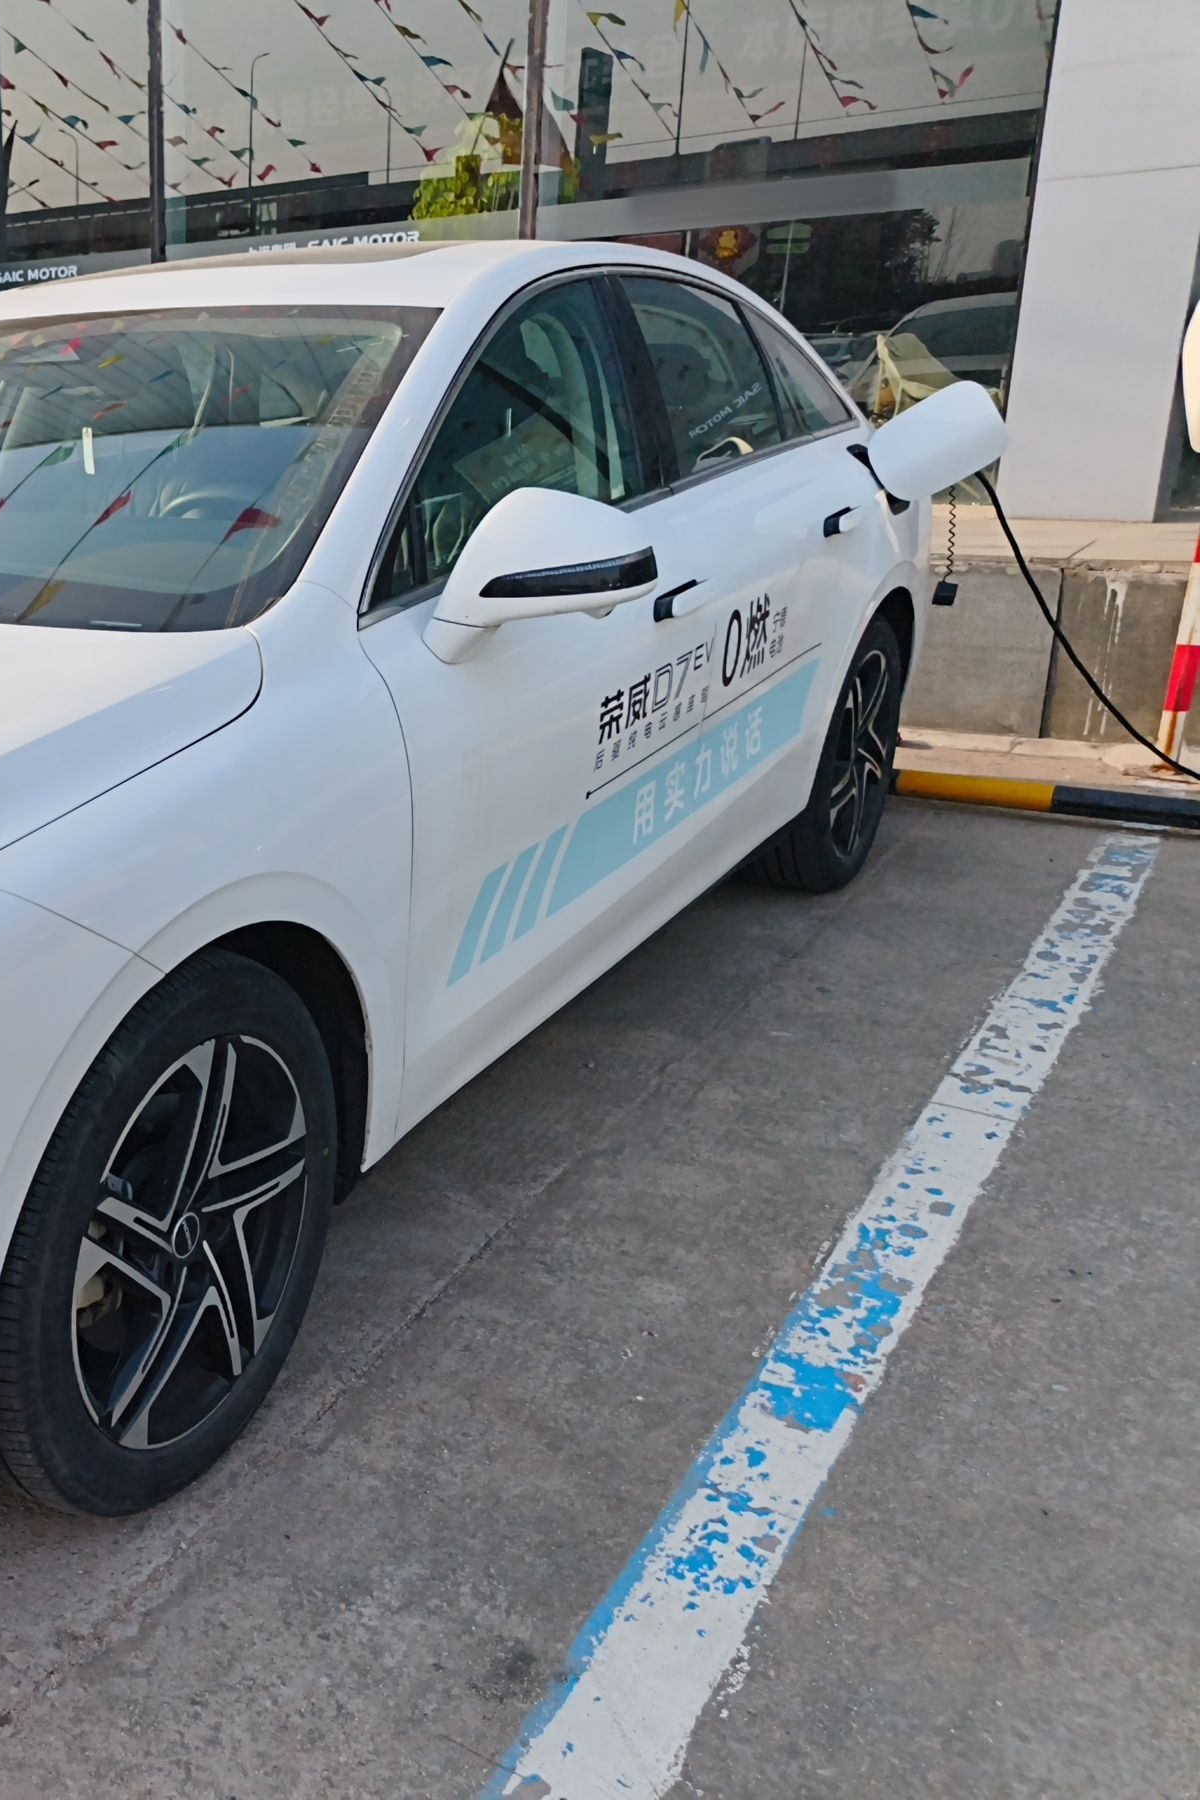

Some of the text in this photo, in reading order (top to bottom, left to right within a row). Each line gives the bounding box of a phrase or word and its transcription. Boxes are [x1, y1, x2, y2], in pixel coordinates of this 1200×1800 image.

[353, 231, 421, 247] MOTOR
[27, 264, 79, 282] MOTOR
[633, 706, 764, 845] 用实力说话
